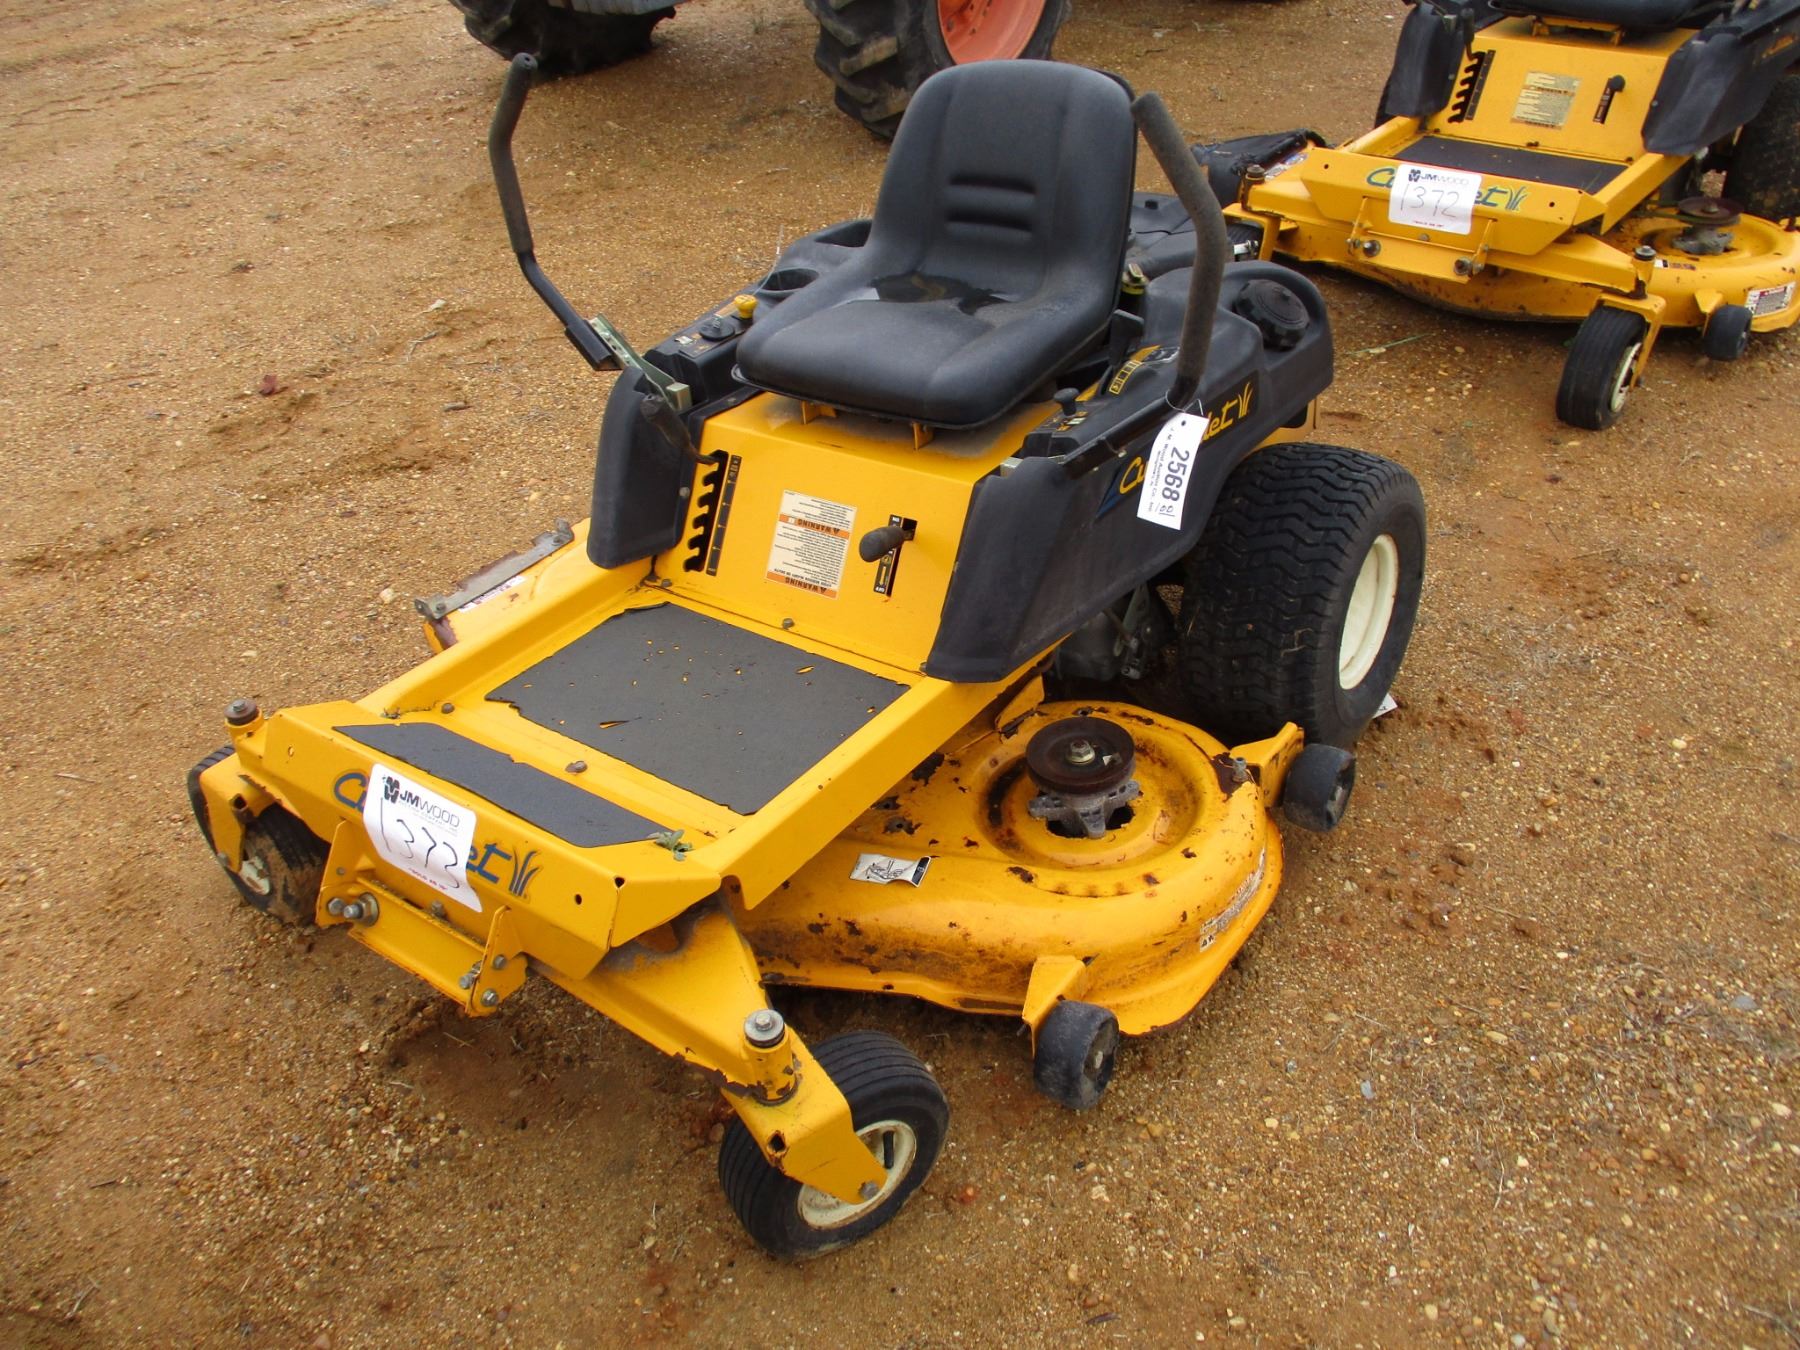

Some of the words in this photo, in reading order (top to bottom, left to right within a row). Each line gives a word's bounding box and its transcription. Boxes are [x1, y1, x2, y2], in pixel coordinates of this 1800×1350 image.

[1400, 183, 1460, 218] 1372
[1162, 446, 1190, 502] 2568
[797, 518, 832, 533] WARNING
[785, 577, 820, 593] WARNING
[400, 790, 460, 828] JMWOOD
